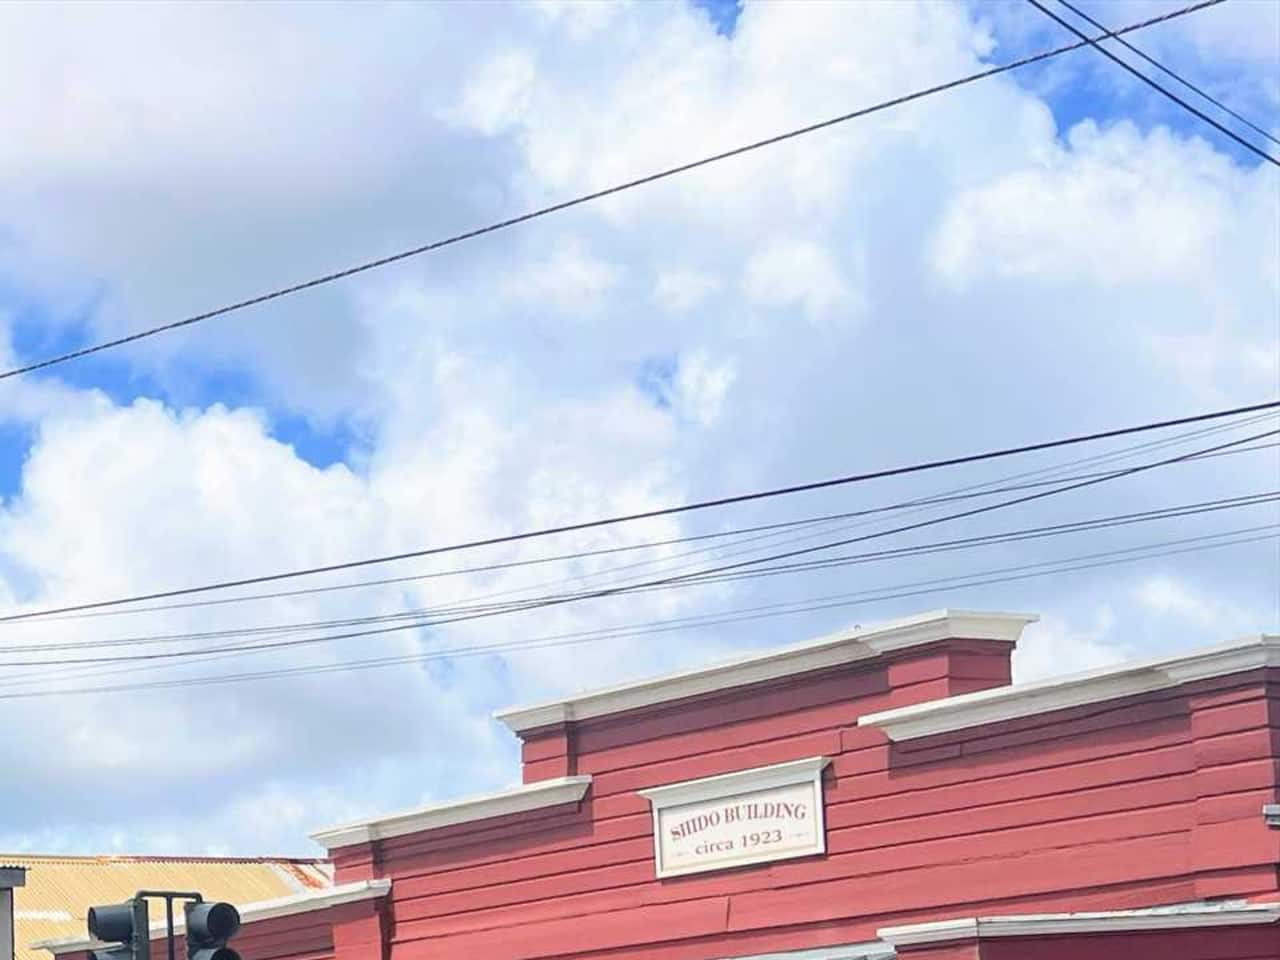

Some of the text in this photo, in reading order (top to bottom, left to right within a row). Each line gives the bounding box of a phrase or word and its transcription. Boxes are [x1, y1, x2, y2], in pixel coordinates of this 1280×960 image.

[671, 802, 807, 840] SHIDO BUILDING
[695, 830, 783, 855] circa 1923
